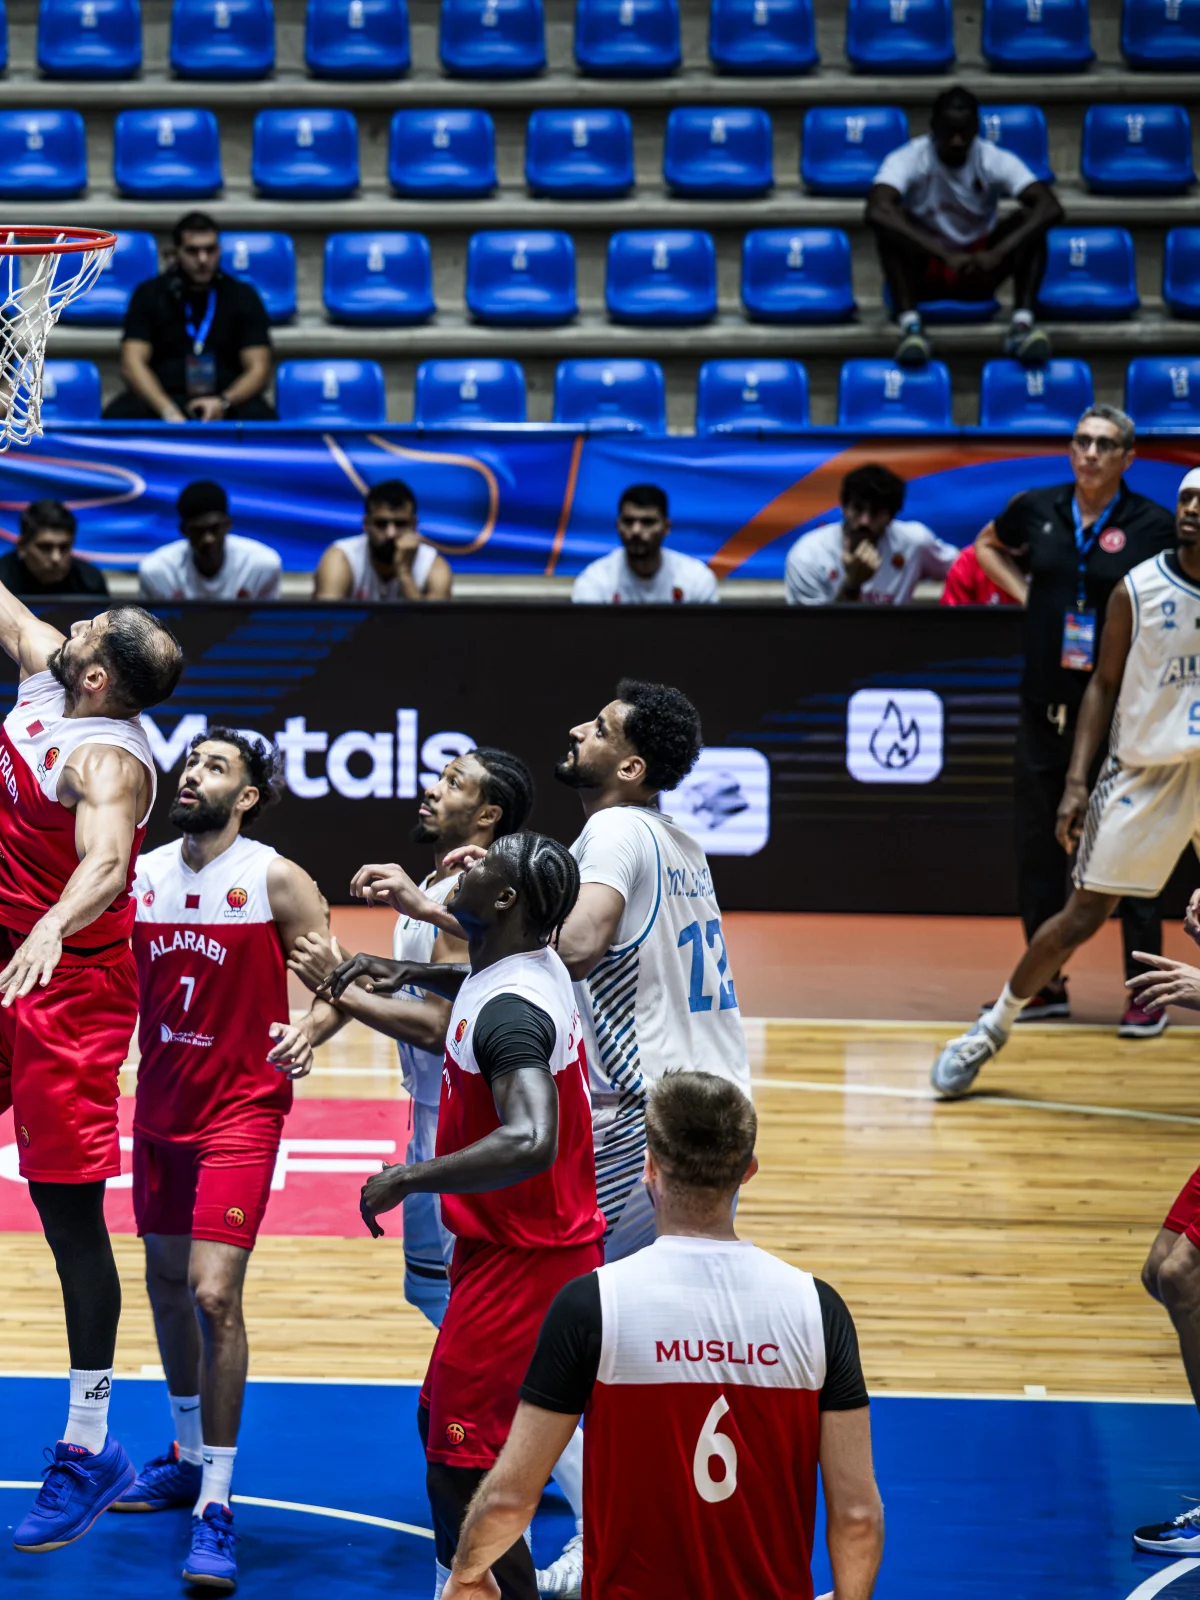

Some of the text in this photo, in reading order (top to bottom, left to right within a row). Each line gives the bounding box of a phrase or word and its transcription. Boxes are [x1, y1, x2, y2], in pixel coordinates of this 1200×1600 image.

[138, 707, 479, 800] Mtals
[150, 930, 228, 966] ALARABI
[677, 918, 738, 1013] 12
[179, 975, 195, 1012] 7
[655, 1339, 780, 1367] MUSLIC
[84, 1390, 111, 1401] PEA
[693, 1394, 738, 1503] 6
